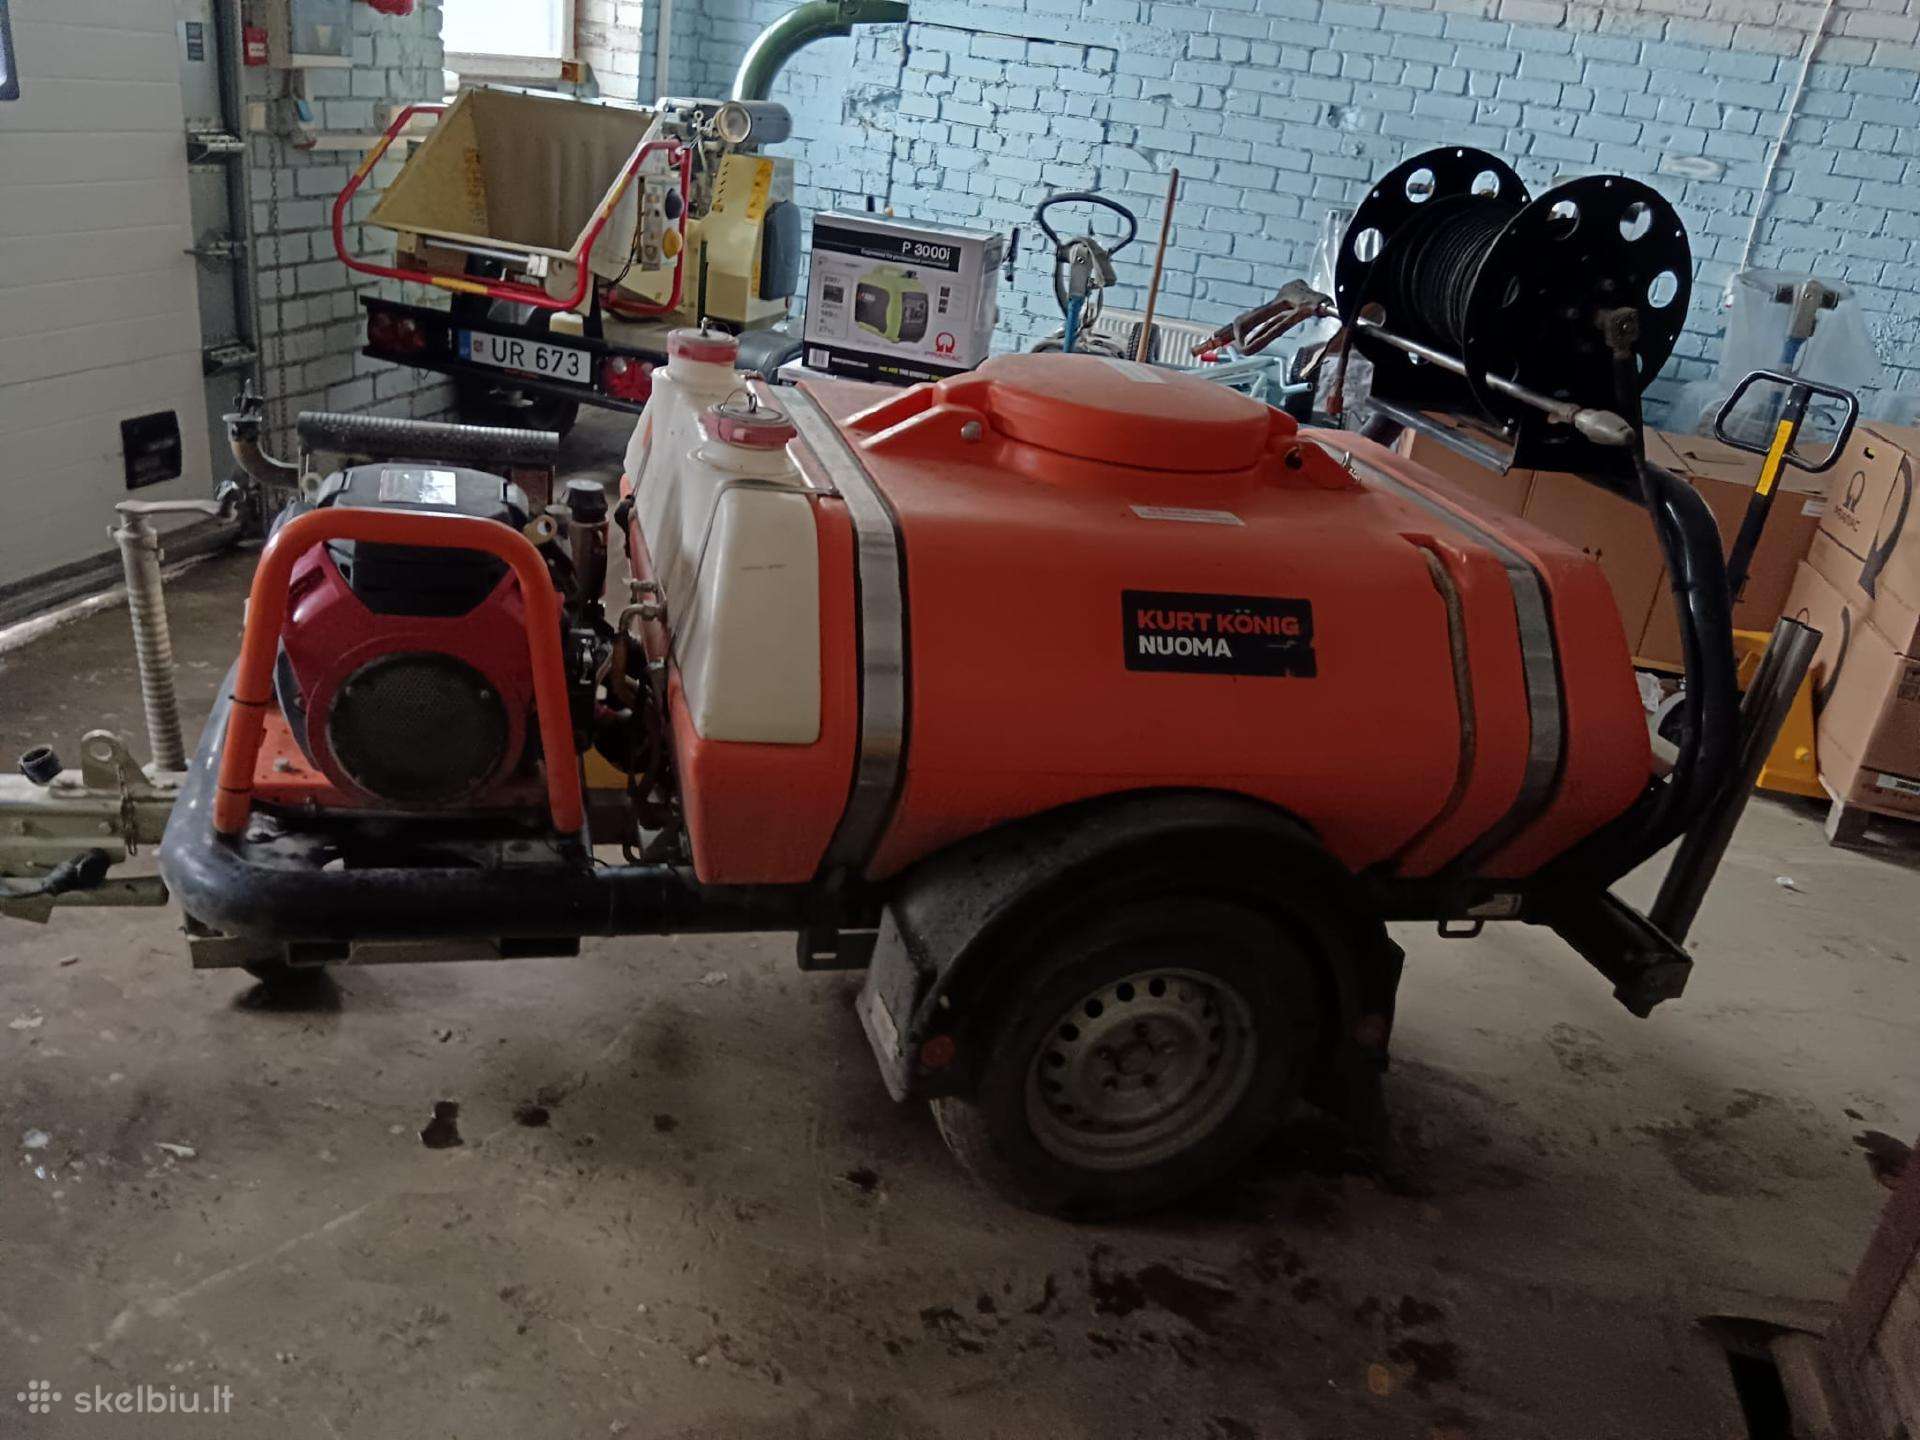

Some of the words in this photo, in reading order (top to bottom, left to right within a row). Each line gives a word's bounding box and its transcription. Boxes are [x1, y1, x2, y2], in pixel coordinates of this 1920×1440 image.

[902, 241, 911, 253] P
[914, 244, 951, 261] 3000i
[491, 338, 525, 367] UR
[535, 347, 580, 377] 673
[1137, 609, 1212, 632] KURT
[1216, 609, 1300, 636] KÖNIG
[1138, 635, 1233, 658] NUOMA
